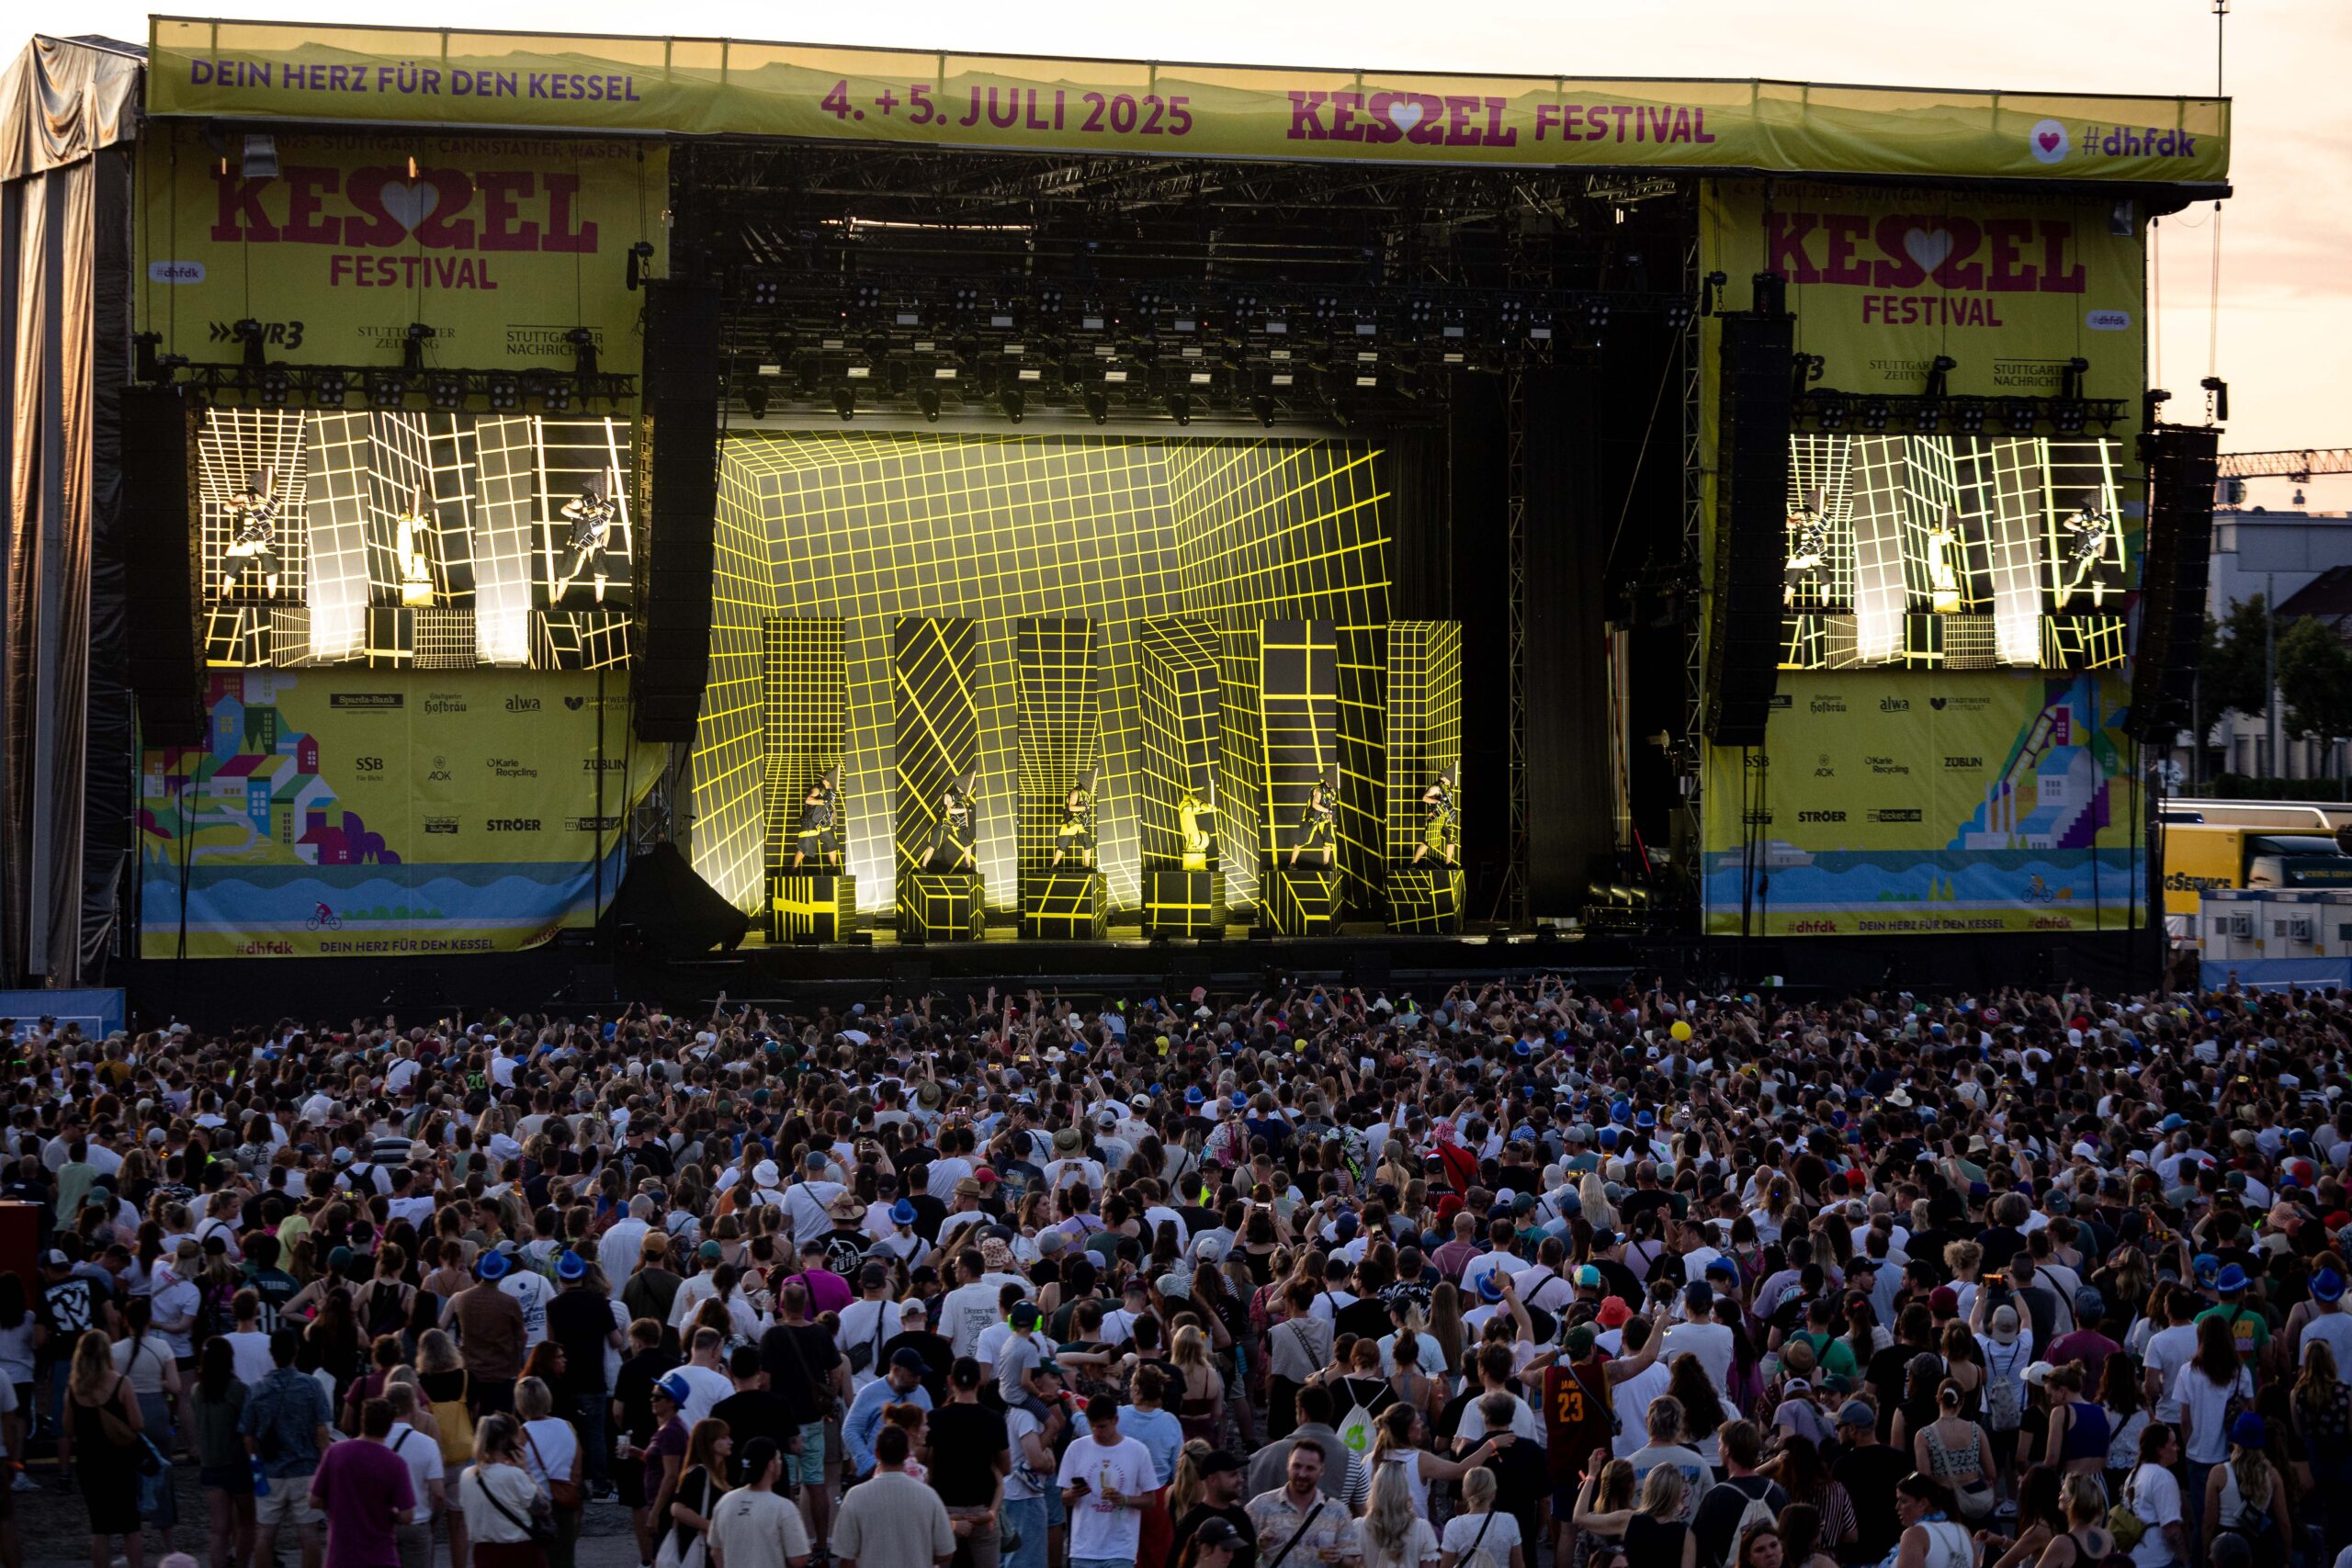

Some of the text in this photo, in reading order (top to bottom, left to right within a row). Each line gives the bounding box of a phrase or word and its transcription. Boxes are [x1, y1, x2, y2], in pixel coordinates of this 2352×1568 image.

[191, 59, 640, 102] DEIN HERZ FÜR DEN KESSEL
[820, 80, 865, 120] 4.
[909, 85, 947, 125] 5.
[959, 85, 1065, 130] JULI
[1080, 92, 1193, 136] 2025
[1286, 90, 1715, 147] KESSEL FESTIVAL
[2082, 127, 2196, 157] #dhfdk
[209, 165, 598, 254] KESSEL
[1761, 212, 2086, 293] KESSEL
[156, 266, 199, 279] #dhfdk
[330, 254, 498, 289] FESTIVAL
[1862, 295, 2003, 327] FESTIVAL
[505, 694, 540, 710] alwa
[1880, 695, 1910, 710] alwa
[356, 757, 384, 772] SSB
[496, 759, 519, 767] Karle
[1872, 765, 1909, 775] Recycling
[428, 771, 452, 781] AOK
[496, 768, 537, 778] Recycling
[1815, 768, 1835, 777] AOK
[1798, 810, 1847, 823] STRÖER
[486, 818, 541, 831] STRÖER
[1788, 921, 1837, 933] #dhfdk
[1859, 919, 2004, 931] DEIN HERZ FÜR DEN KESSEL
[2028, 918, 2072, 929] #dhfdk
[235, 941, 294, 955] #dhfdk
[321, 939, 495, 953] DEIN HERZ FÜR DEN KESSEL
[467, 1074, 485, 1089] 20
[1557, 1392, 1584, 1423] 23
